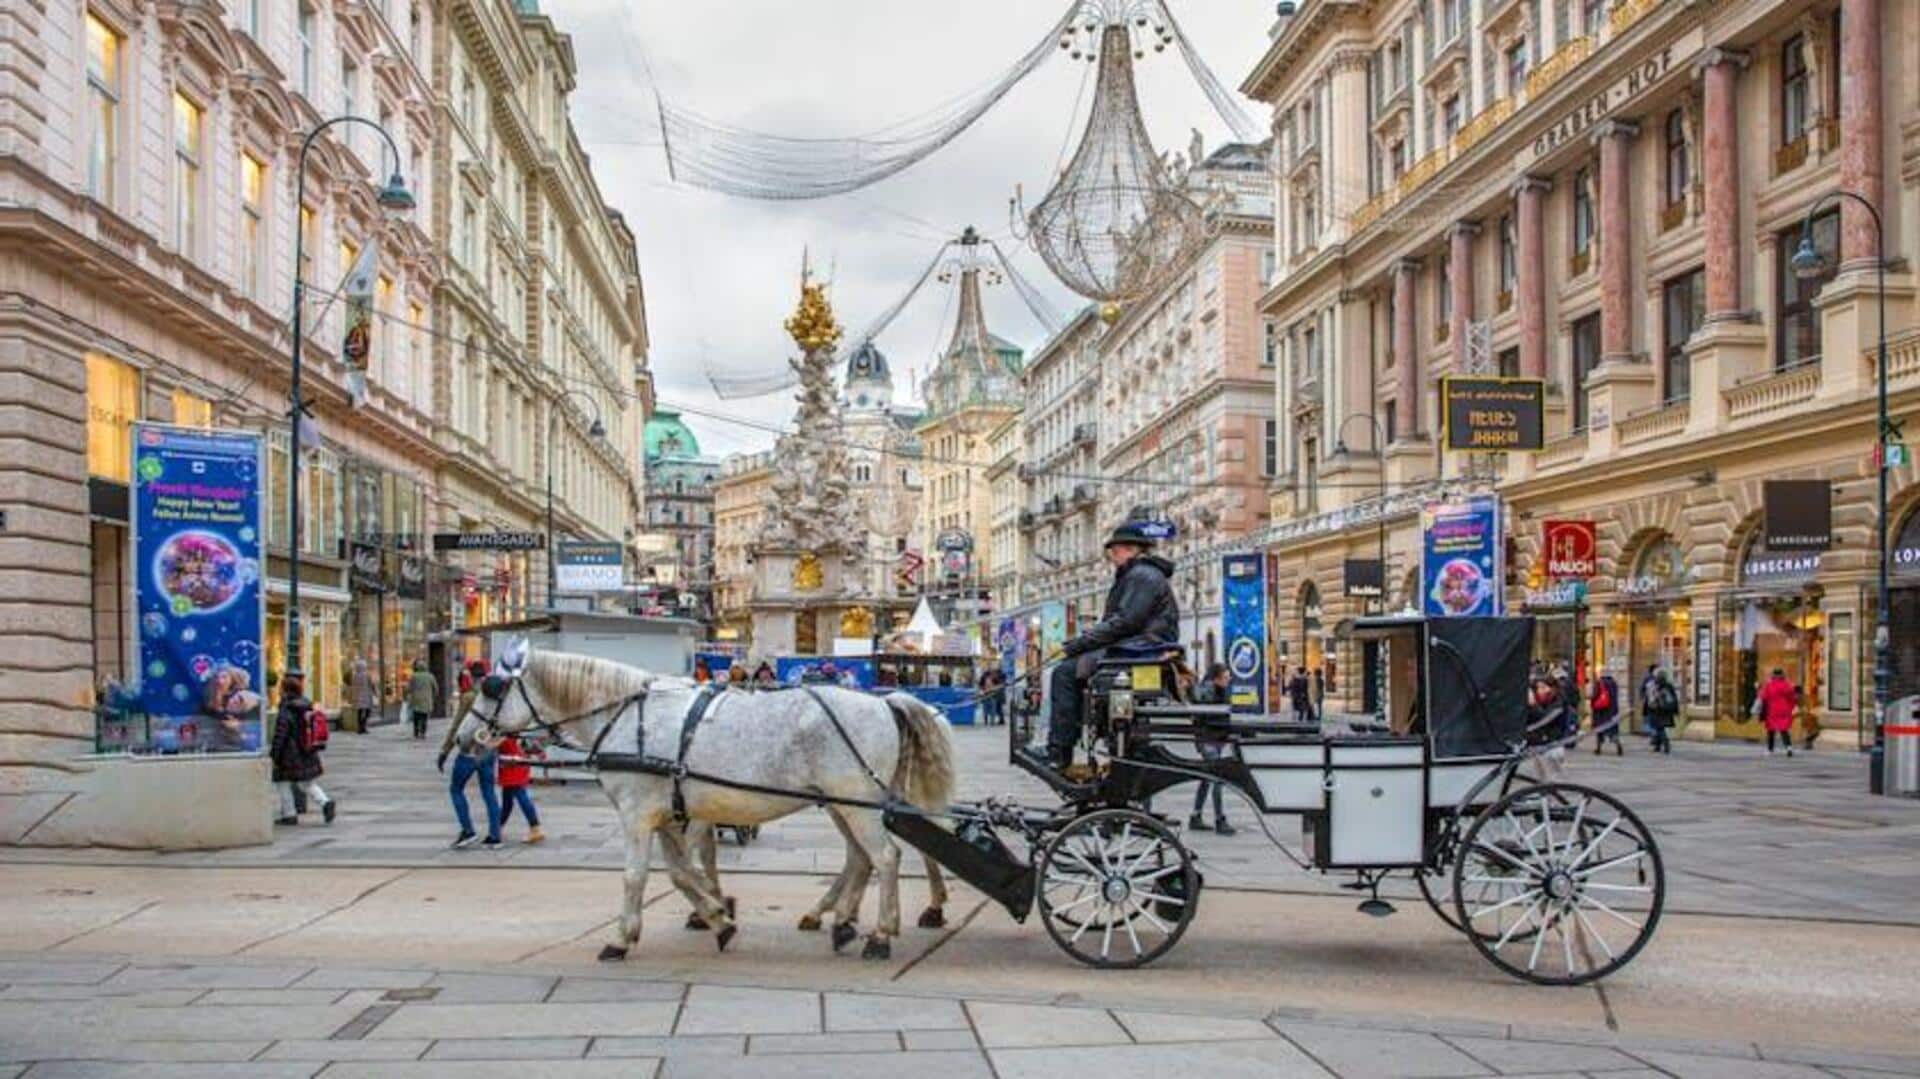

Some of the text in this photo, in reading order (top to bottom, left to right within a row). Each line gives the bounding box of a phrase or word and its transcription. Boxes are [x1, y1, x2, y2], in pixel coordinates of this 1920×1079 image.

[1534, 92, 1608, 155] GRABEN
[1628, 50, 1672, 97] HOF
[1769, 535, 1829, 545] LONGCHAMP
[1549, 560, 1594, 574] RAUCH
[1744, 556, 1821, 575] LONGCHAMP
[1617, 575, 1659, 593] RAUCH
